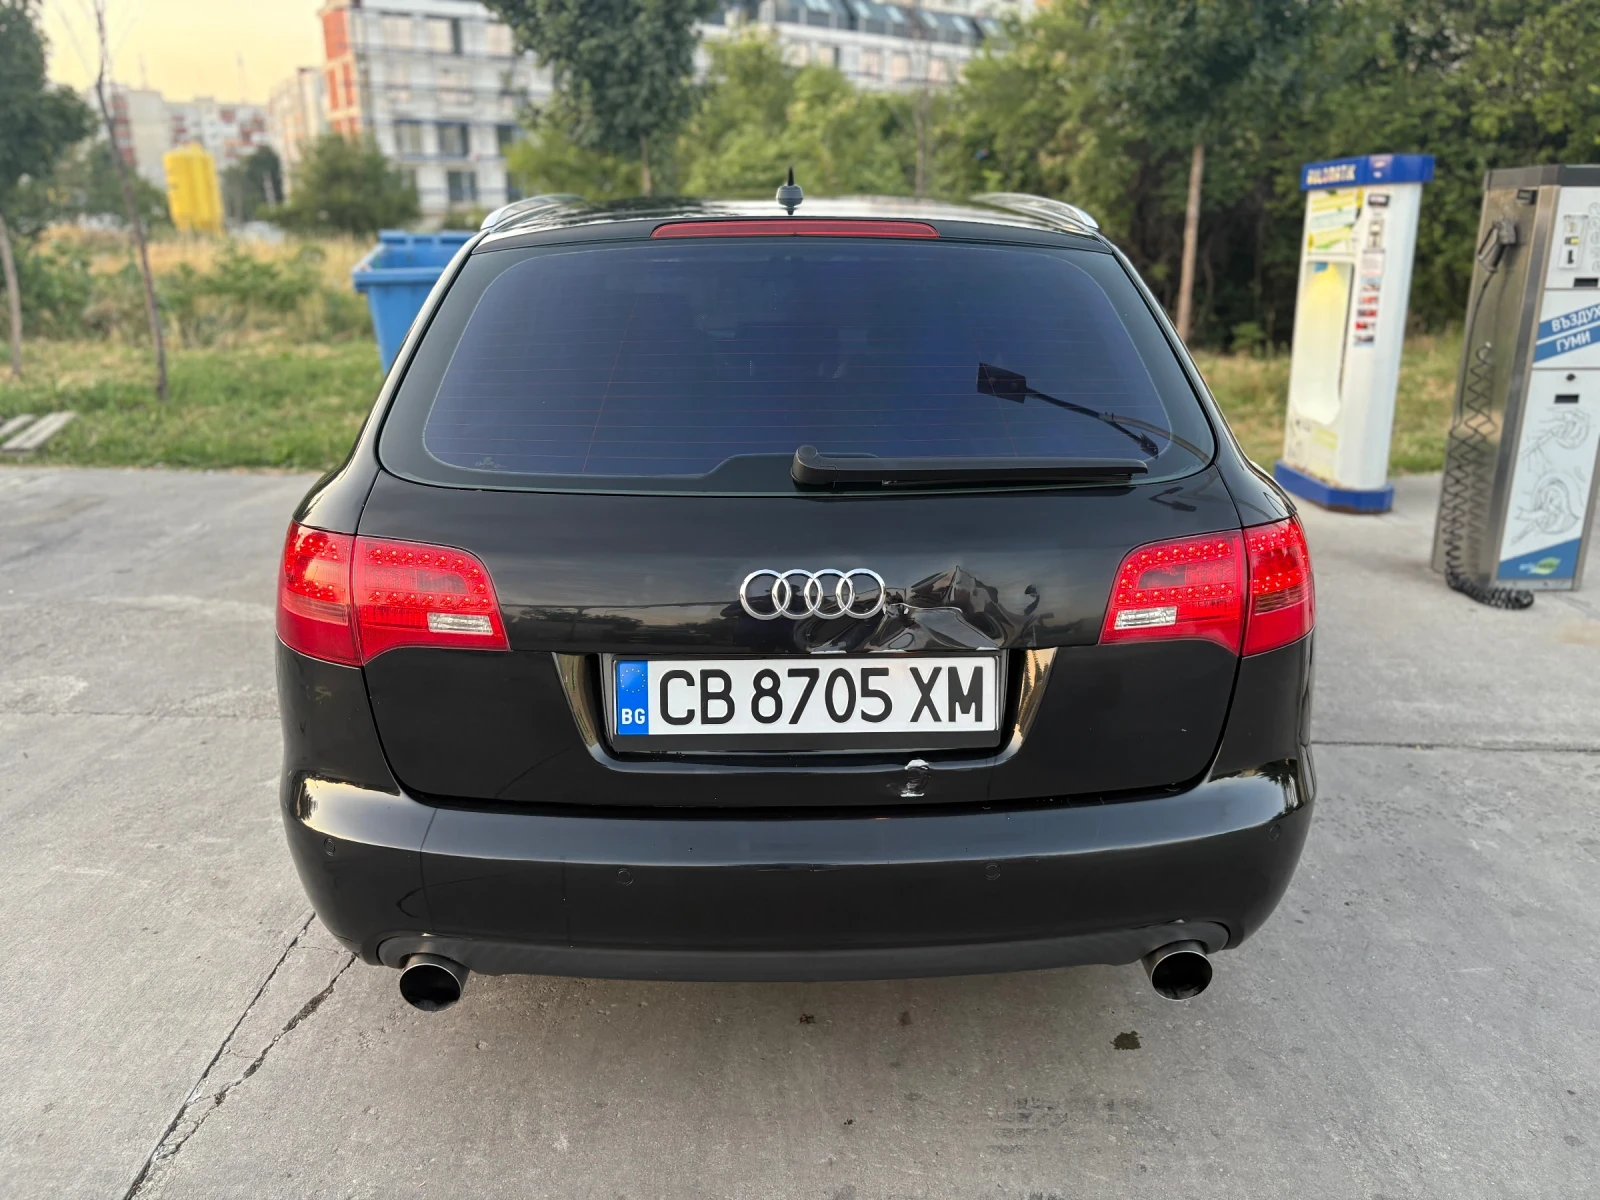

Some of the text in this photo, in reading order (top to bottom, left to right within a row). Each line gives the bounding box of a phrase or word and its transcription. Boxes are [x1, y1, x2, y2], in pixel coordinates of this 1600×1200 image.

[1556, 330, 1591, 353] ГУМИ
[660, 666, 984, 725] CB 8705 XM
[621, 708, 646, 725] BG
